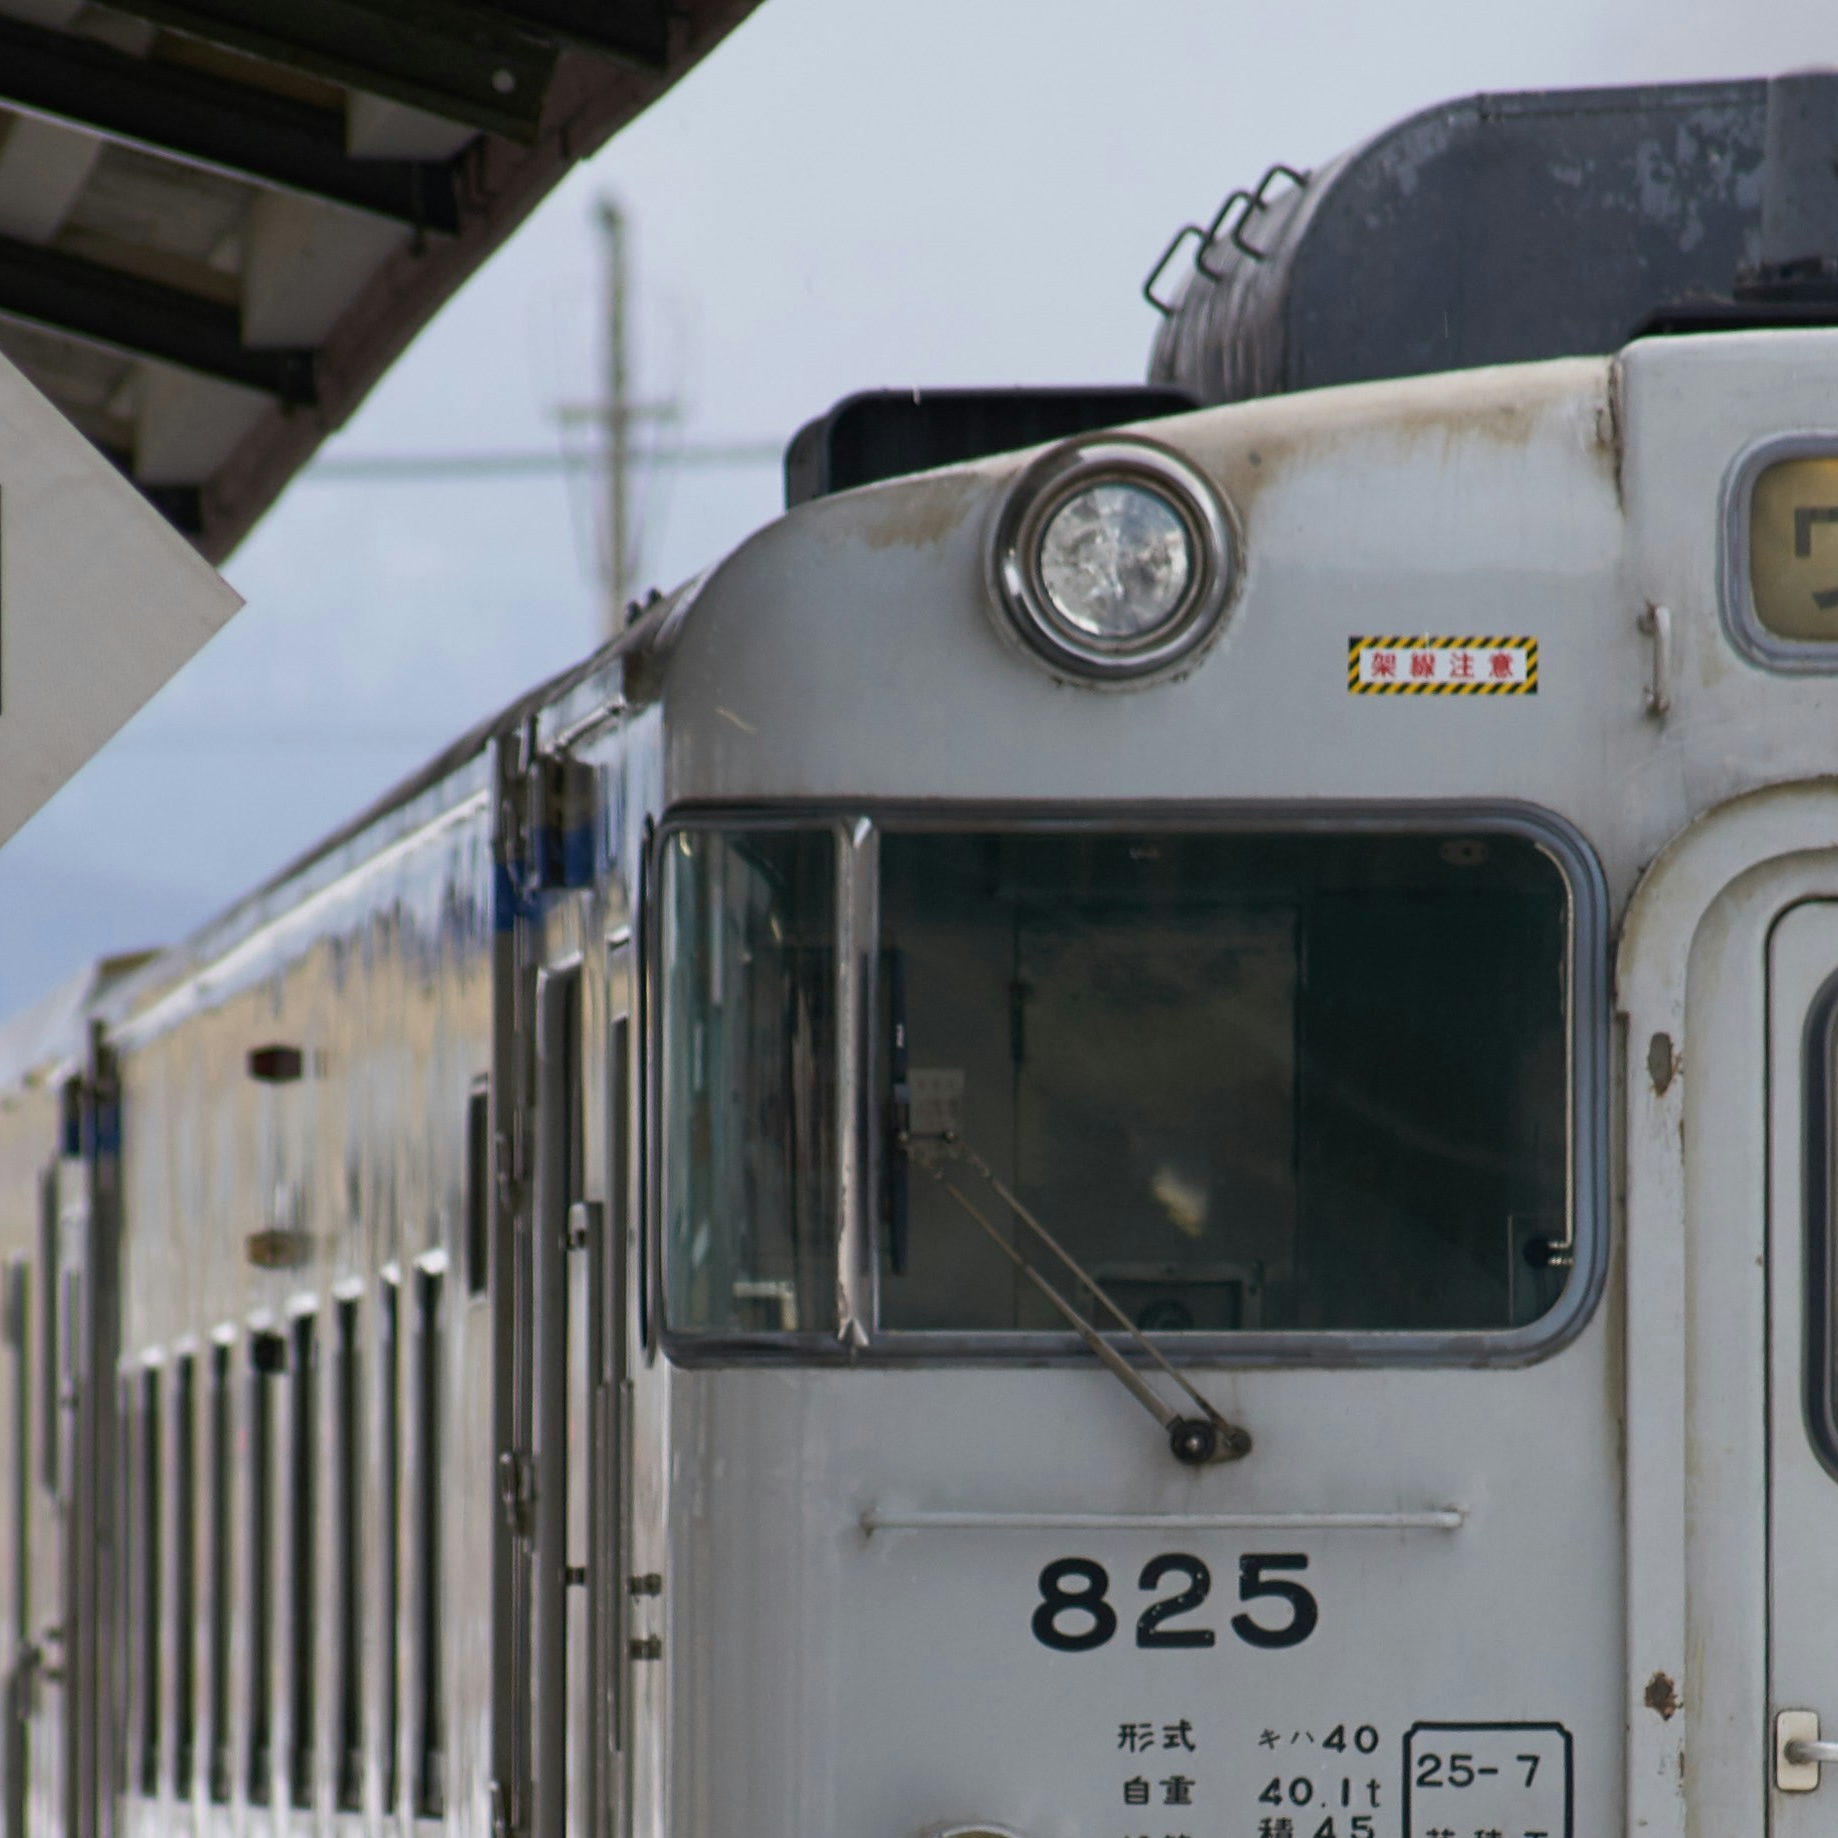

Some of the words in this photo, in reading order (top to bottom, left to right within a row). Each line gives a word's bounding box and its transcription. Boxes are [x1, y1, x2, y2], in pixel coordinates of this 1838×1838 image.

[1371, 651, 1514, 678] 架線注意
[1031, 1552, 1319, 1653] 825
[1118, 1719, 1196, 1752] 形式
[1258, 1723, 1380, 1754] キハ40
[1123, 1776, 1196, 1806] 自重
